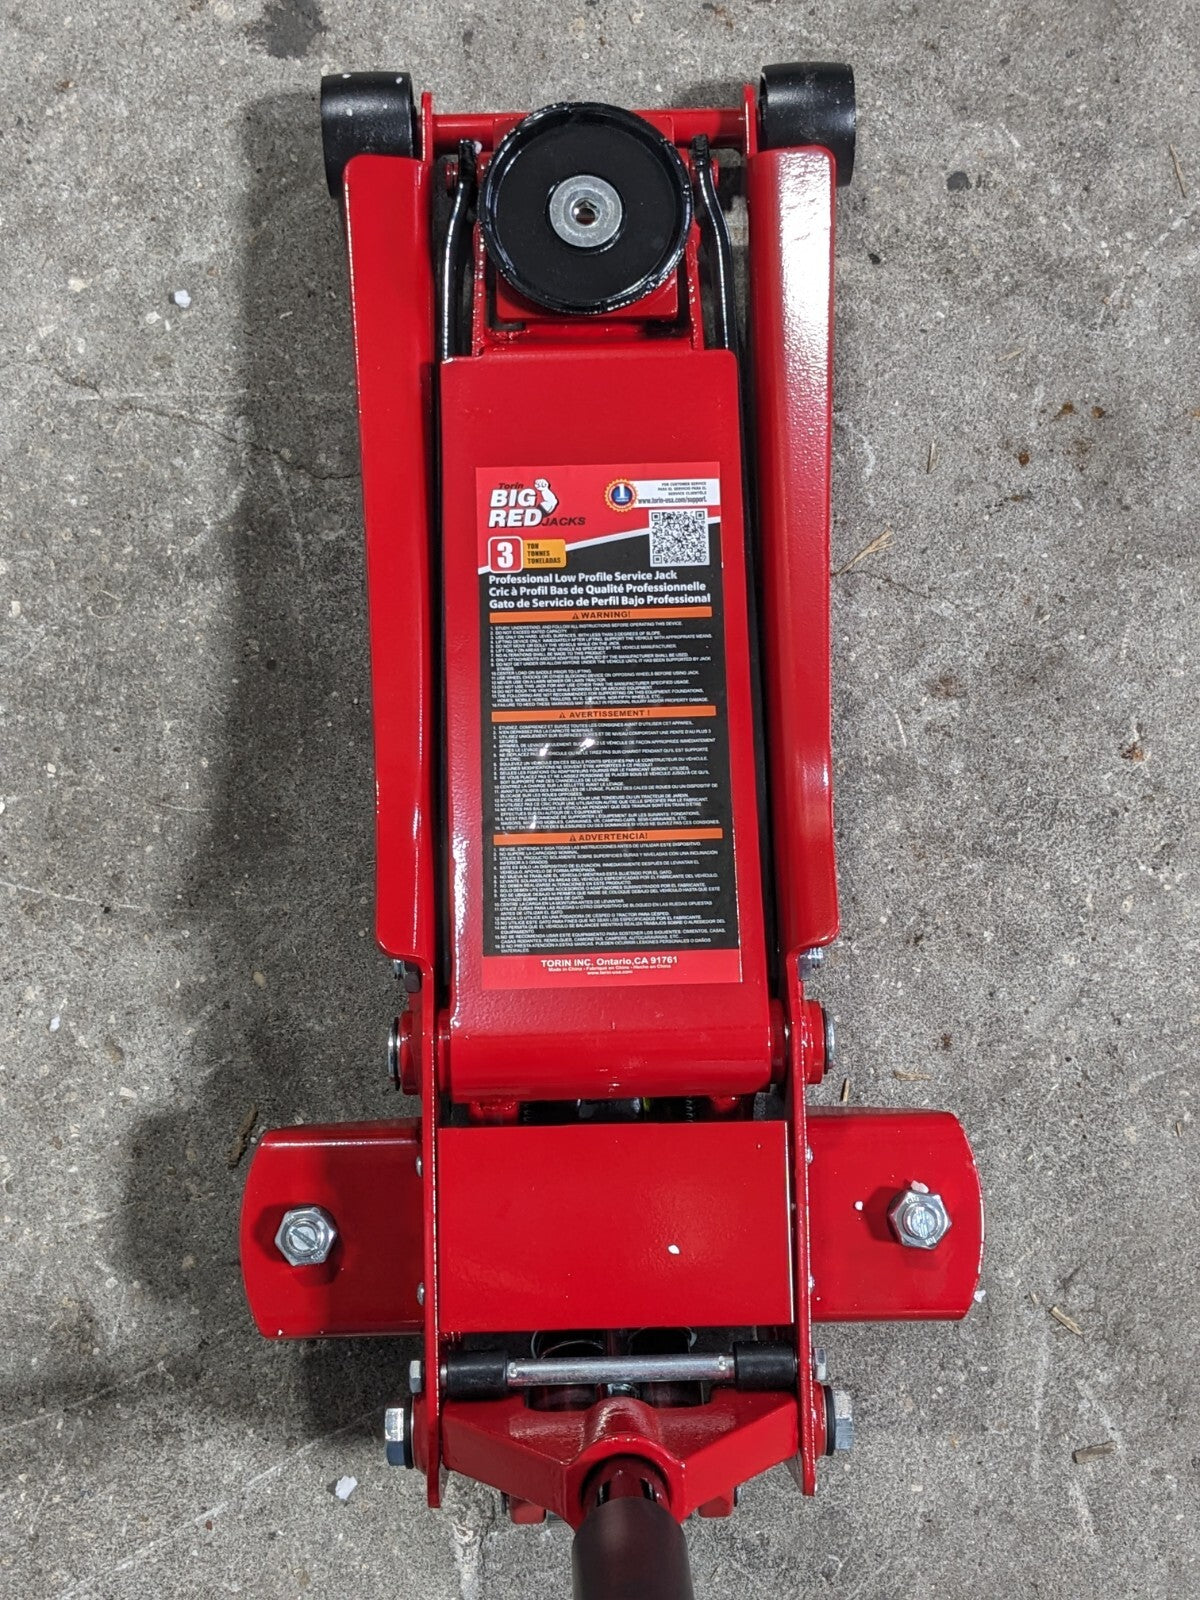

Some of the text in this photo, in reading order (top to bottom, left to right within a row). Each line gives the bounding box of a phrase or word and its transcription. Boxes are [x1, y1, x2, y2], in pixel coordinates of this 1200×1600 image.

[490, 489, 536, 507] BIG
[488, 508, 586, 528] RED JACKS
[497, 542, 513, 568] 3
[489, 570, 677, 584] Professional Low Profile Service Jack
[489, 581, 706, 596] Cric à Profil Bas de Qualité Professionnelle
[489, 593, 711, 609] Gato de Servicio de Perfil Bajo Professional
[581, 611, 631, 619] WARNING!
[569, 710, 644, 718] AVERTISSEMENT
[578, 832, 648, 840] ADVERTENCIA!
[651, 956, 677, 964] 91761
